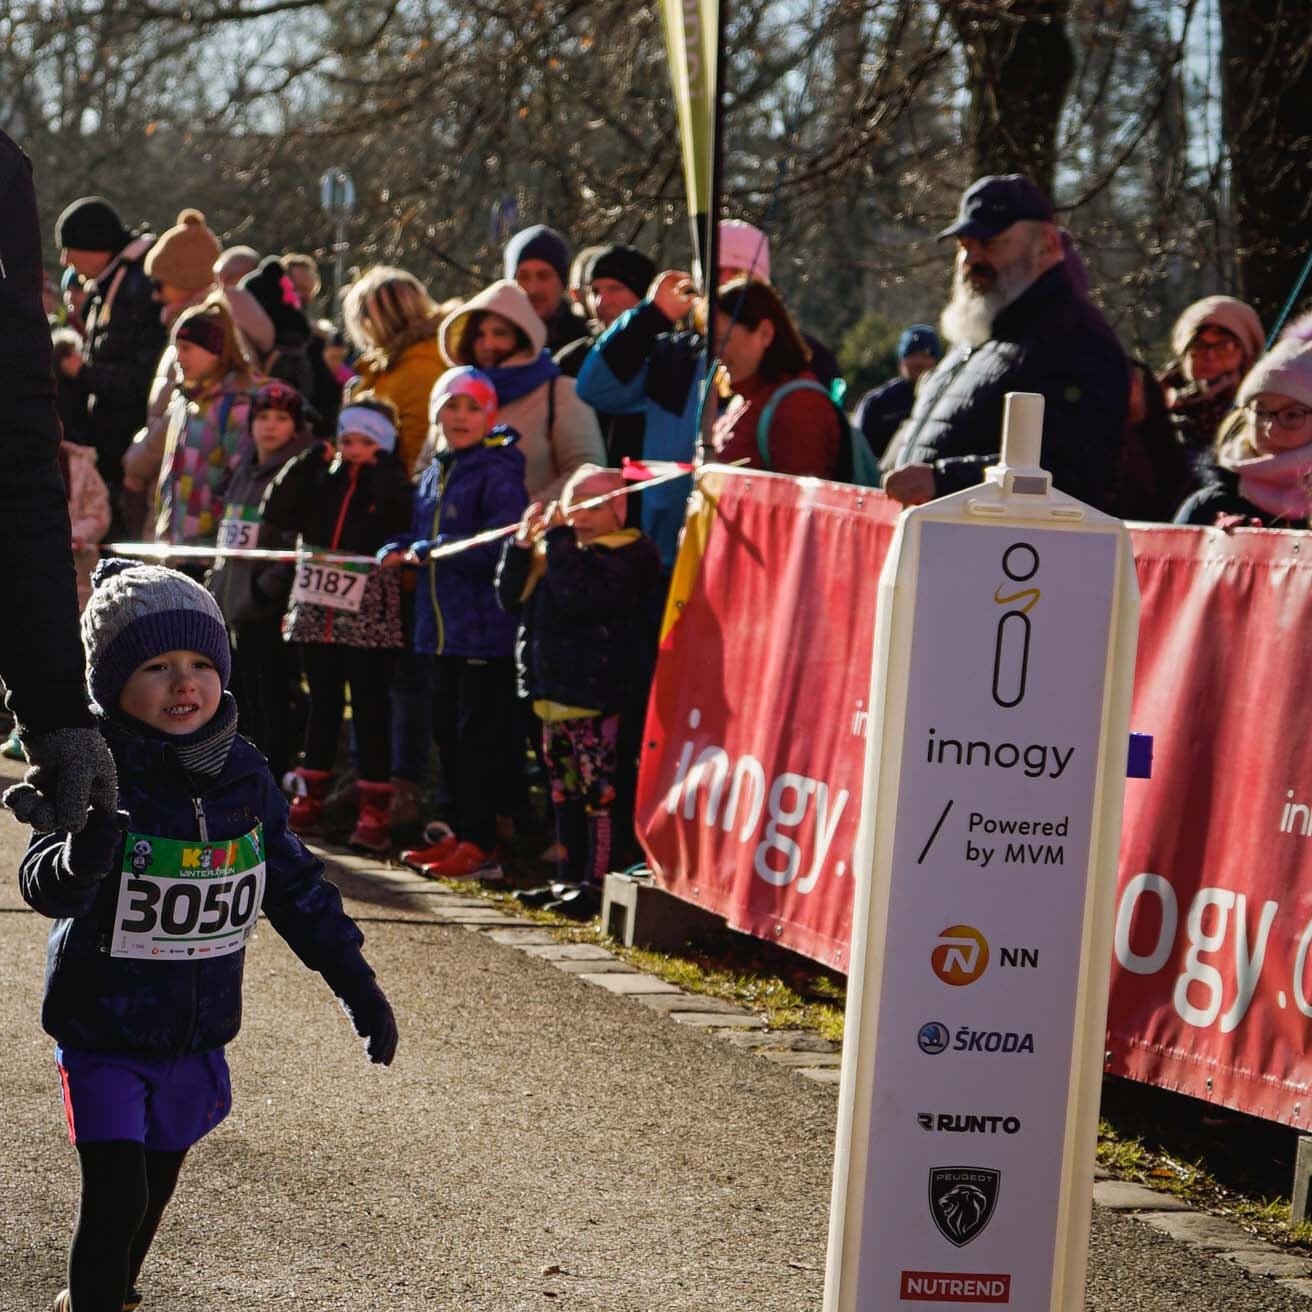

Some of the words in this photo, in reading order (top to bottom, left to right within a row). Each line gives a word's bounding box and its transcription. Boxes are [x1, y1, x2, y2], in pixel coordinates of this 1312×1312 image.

[299, 567, 358, 597] 3187
[927, 728, 1075, 778] innogy
[968, 812, 1069, 837] Powered
[966, 840, 994, 867] by
[1004, 843, 1064, 865] MVM
[121, 873, 257, 936] 3050
[999, 947, 1039, 968] NN
[952, 1026, 1035, 1054] ŠKODA
[937, 1114, 1021, 1134] RUNTO
[936, 1173, 993, 1183] PEUGEOT
[907, 1277, 1006, 1297] NUTREND
